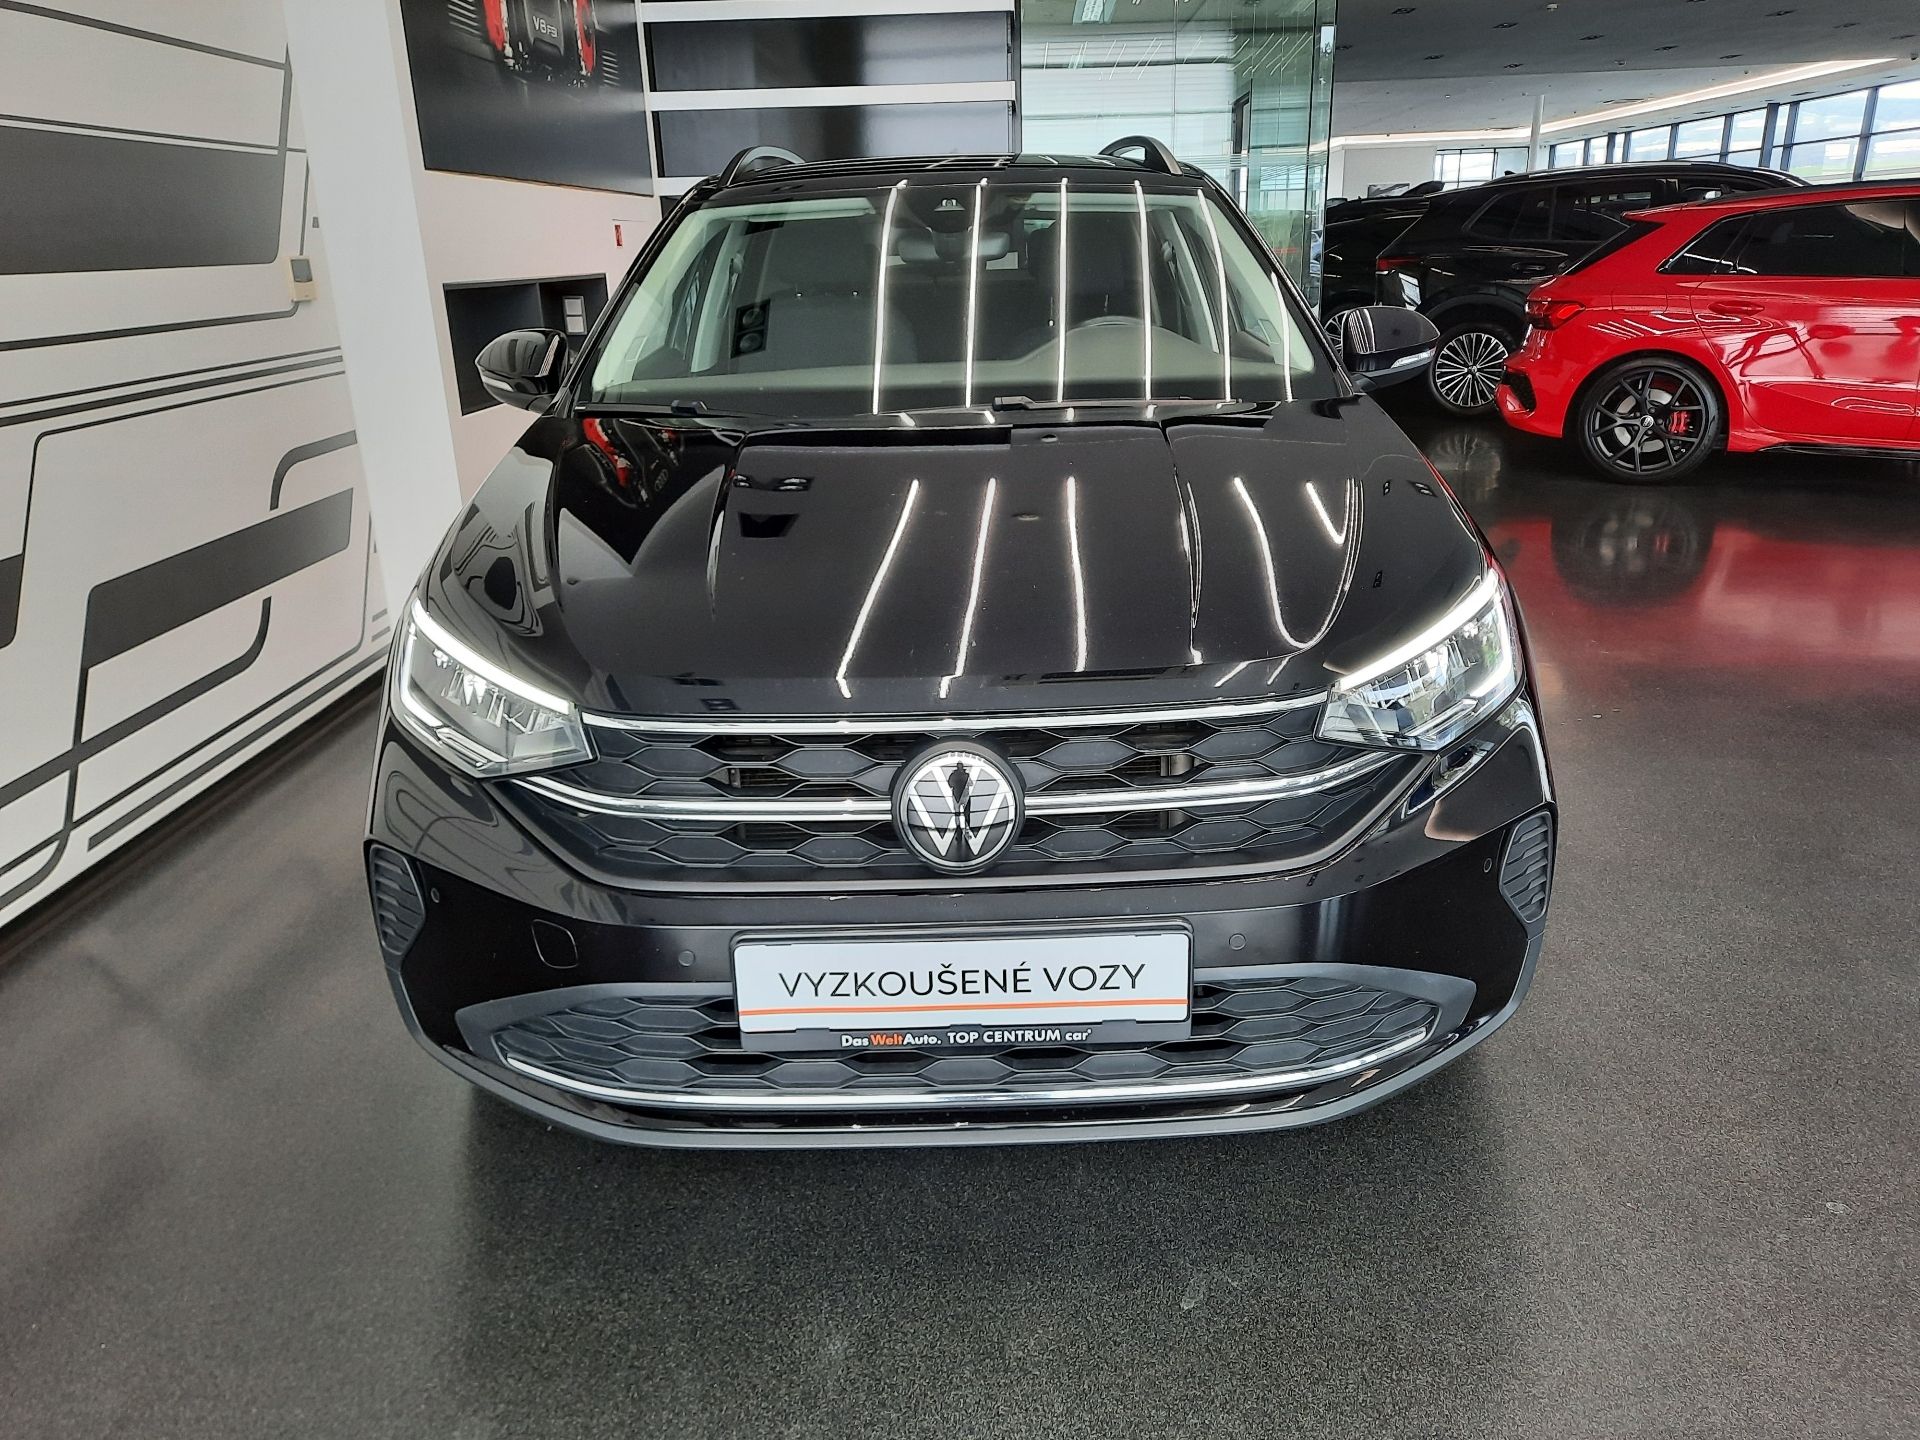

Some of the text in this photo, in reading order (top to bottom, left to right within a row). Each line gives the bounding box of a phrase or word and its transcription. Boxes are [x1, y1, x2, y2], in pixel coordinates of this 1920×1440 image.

[778, 961, 1146, 998] VYZKOUŠENÉ VOZY
[947, 1031, 979, 1044] TOP
[983, 1028, 1060, 1043] CENTRUM
